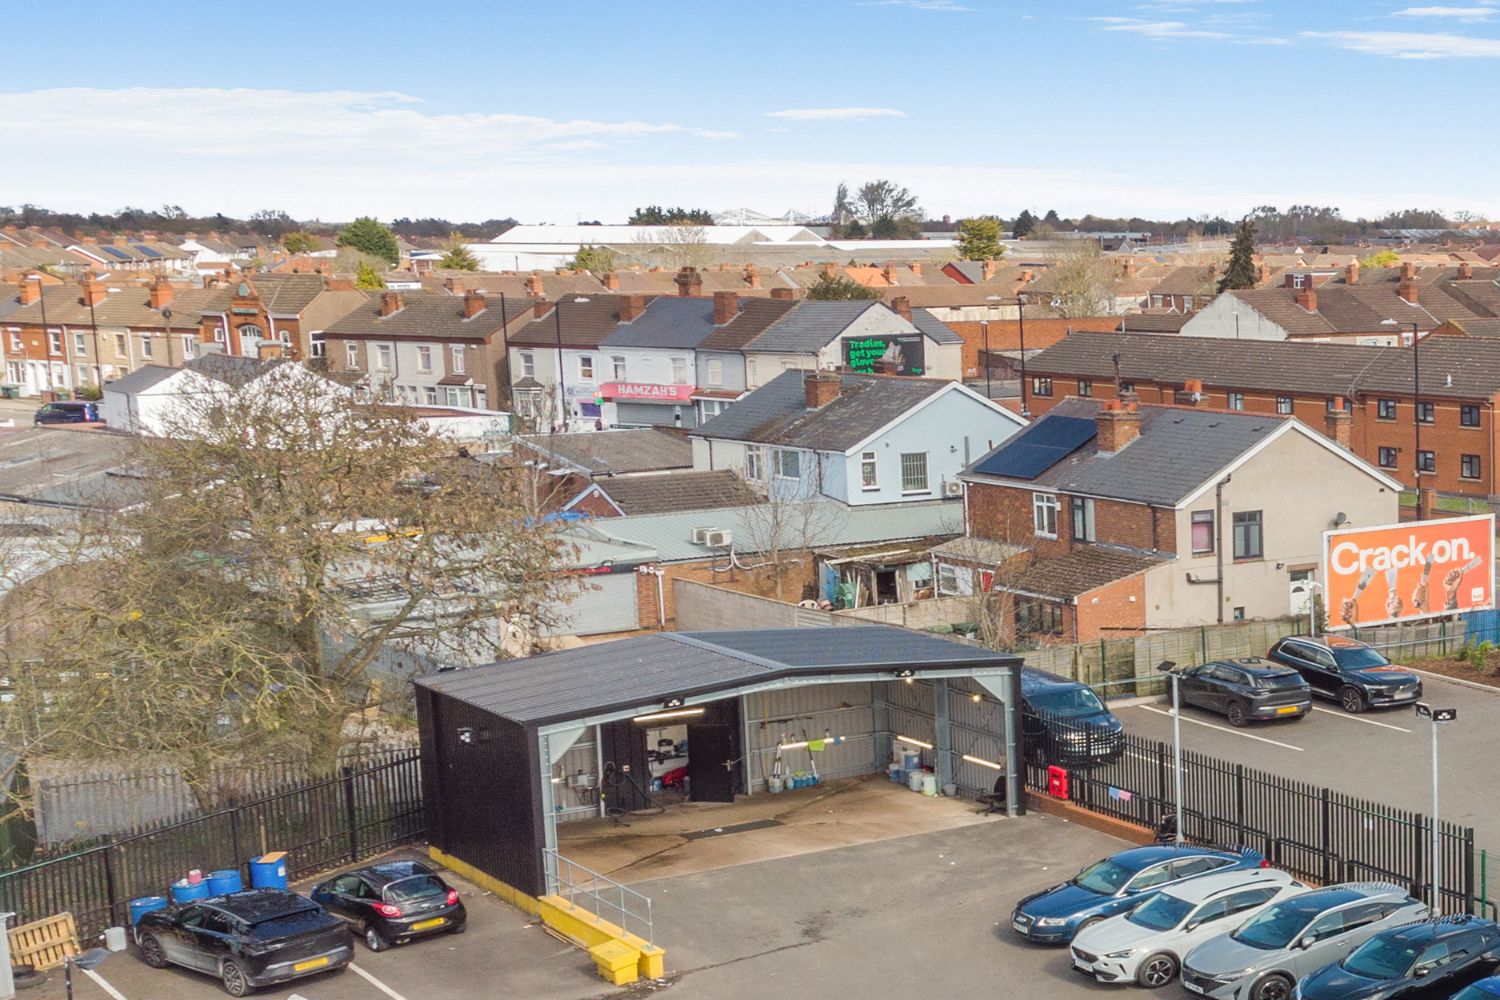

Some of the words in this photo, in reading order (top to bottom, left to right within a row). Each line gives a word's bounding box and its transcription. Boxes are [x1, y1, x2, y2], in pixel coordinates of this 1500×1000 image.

[850, 349, 866, 359] get
[617, 385, 678, 396] HAMZAH'S
[1331, 535, 1427, 575] Crack
[1432, 537, 1476, 563] on.
